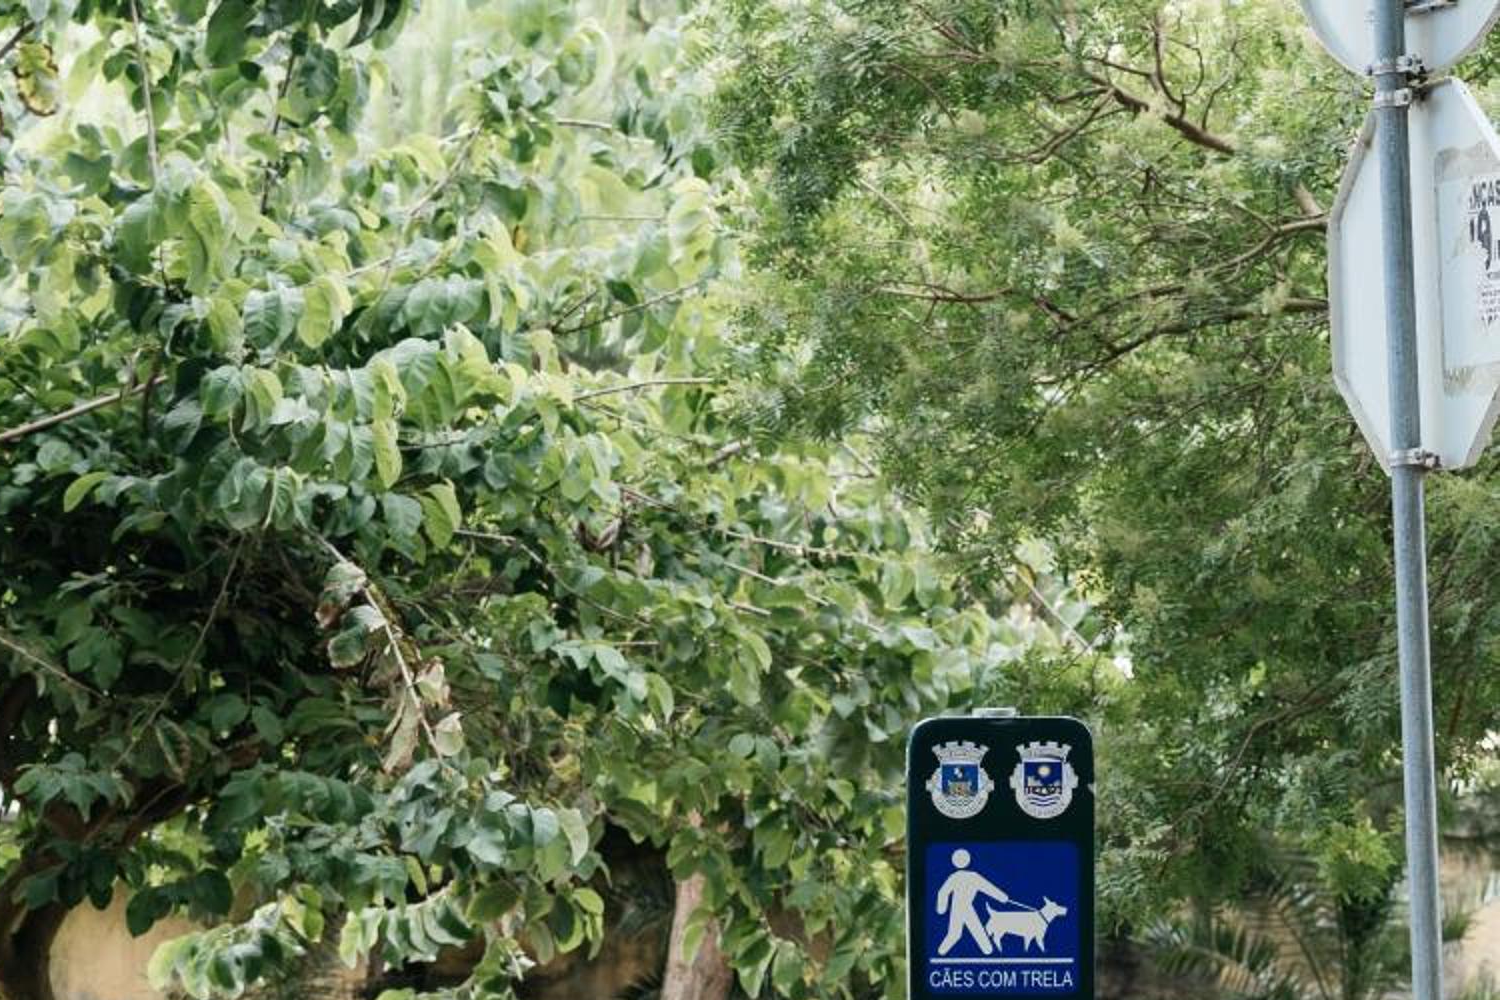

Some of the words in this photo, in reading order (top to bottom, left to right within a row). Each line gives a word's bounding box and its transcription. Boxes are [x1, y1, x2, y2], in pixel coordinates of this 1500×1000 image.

[930, 967, 975, 988] CÃES
[978, 970, 1017, 988] COM
[1021, 970, 1073, 988] TRELA
